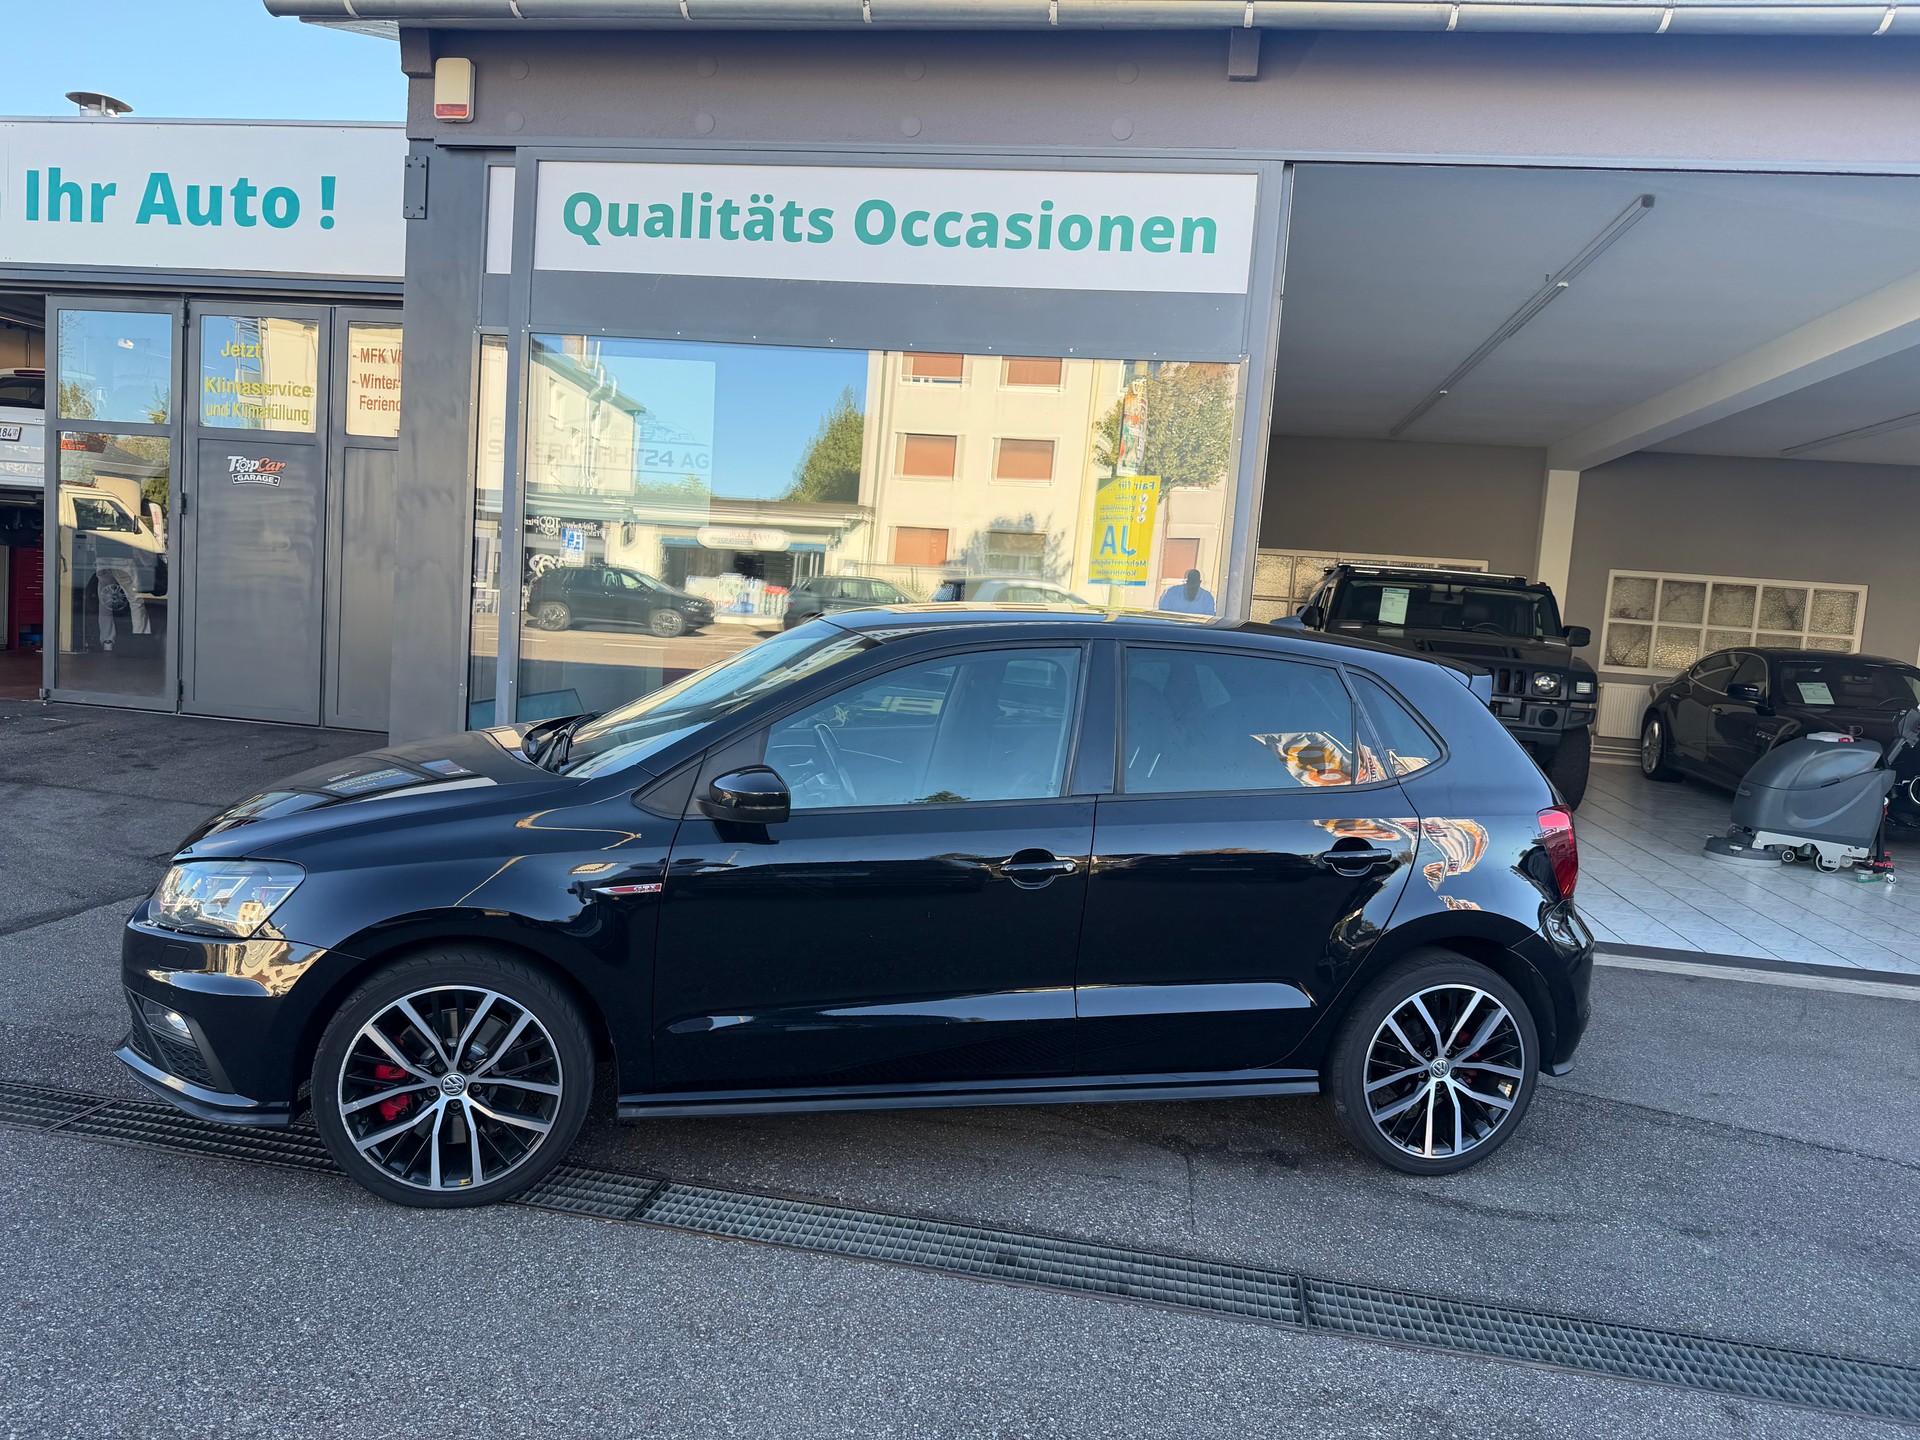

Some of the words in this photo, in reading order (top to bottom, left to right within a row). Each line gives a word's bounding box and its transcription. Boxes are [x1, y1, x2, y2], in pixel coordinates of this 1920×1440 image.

[26, 167, 117, 223] Ihr
[136, 172, 301, 229] Auto
[319, 175, 337, 230] !
[563, 192, 833, 246] Qualitäts
[854, 199, 1218, 254] Occasionen
[221, 341, 262, 358] Jetzt
[360, 347, 386, 364] MFK
[205, 377, 312, 398] Klimaservice
[360, 373, 400, 390] Winter
[206, 401, 229, 417] und
[232, 402, 309, 426] Klimafüllung
[0, 428, 12, 437] 84
[680, 453, 710, 469] AG
[237, 474, 275, 483] GARAGE
